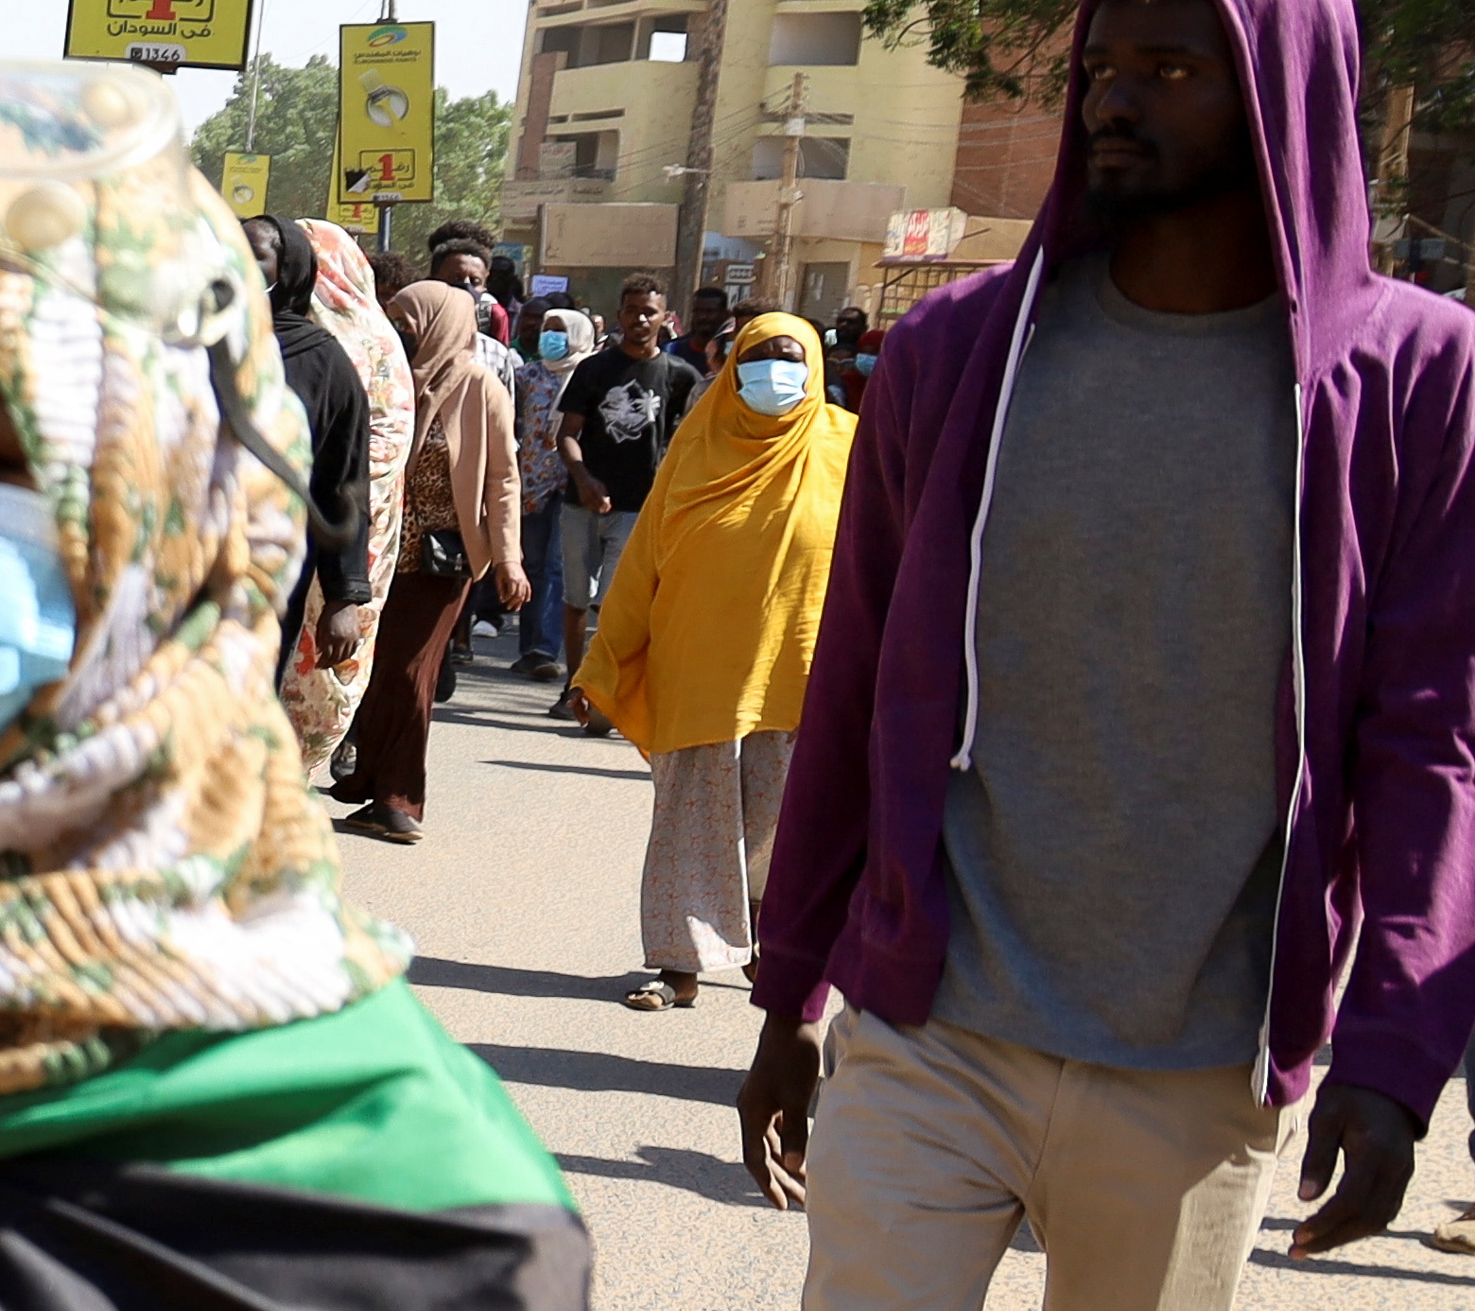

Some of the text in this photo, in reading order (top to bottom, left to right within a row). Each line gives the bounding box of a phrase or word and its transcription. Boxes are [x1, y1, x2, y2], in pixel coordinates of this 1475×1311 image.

[107, 20, 178, 37] السودان
[145, 47, 181, 62] 1346
[378, 153, 396, 181] 1
